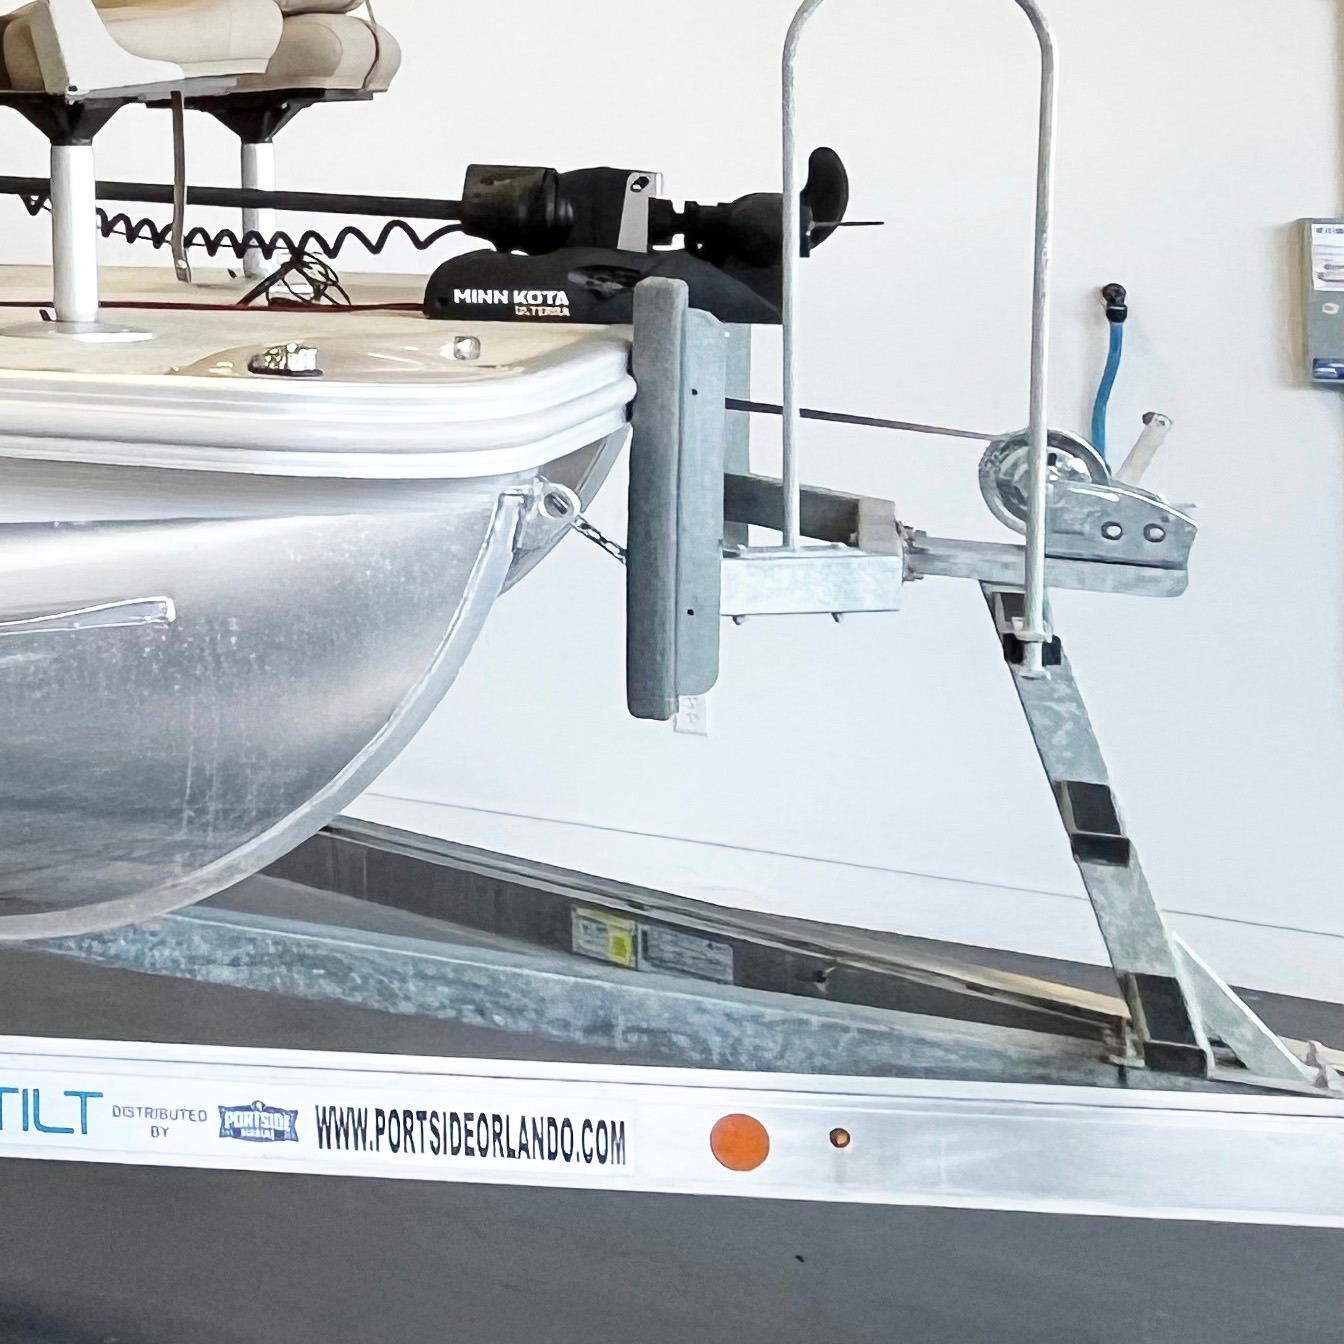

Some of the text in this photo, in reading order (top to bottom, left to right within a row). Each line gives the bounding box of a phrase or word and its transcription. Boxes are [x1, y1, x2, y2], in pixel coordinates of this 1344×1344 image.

[453, 288, 570, 306] MINN KOTA
[111, 1104, 208, 1123] DISTRIBUTED
[150, 1124, 170, 1138] BY
[315, 1104, 627, 1166] WWW.PORTSIDEORLANDO.COM
